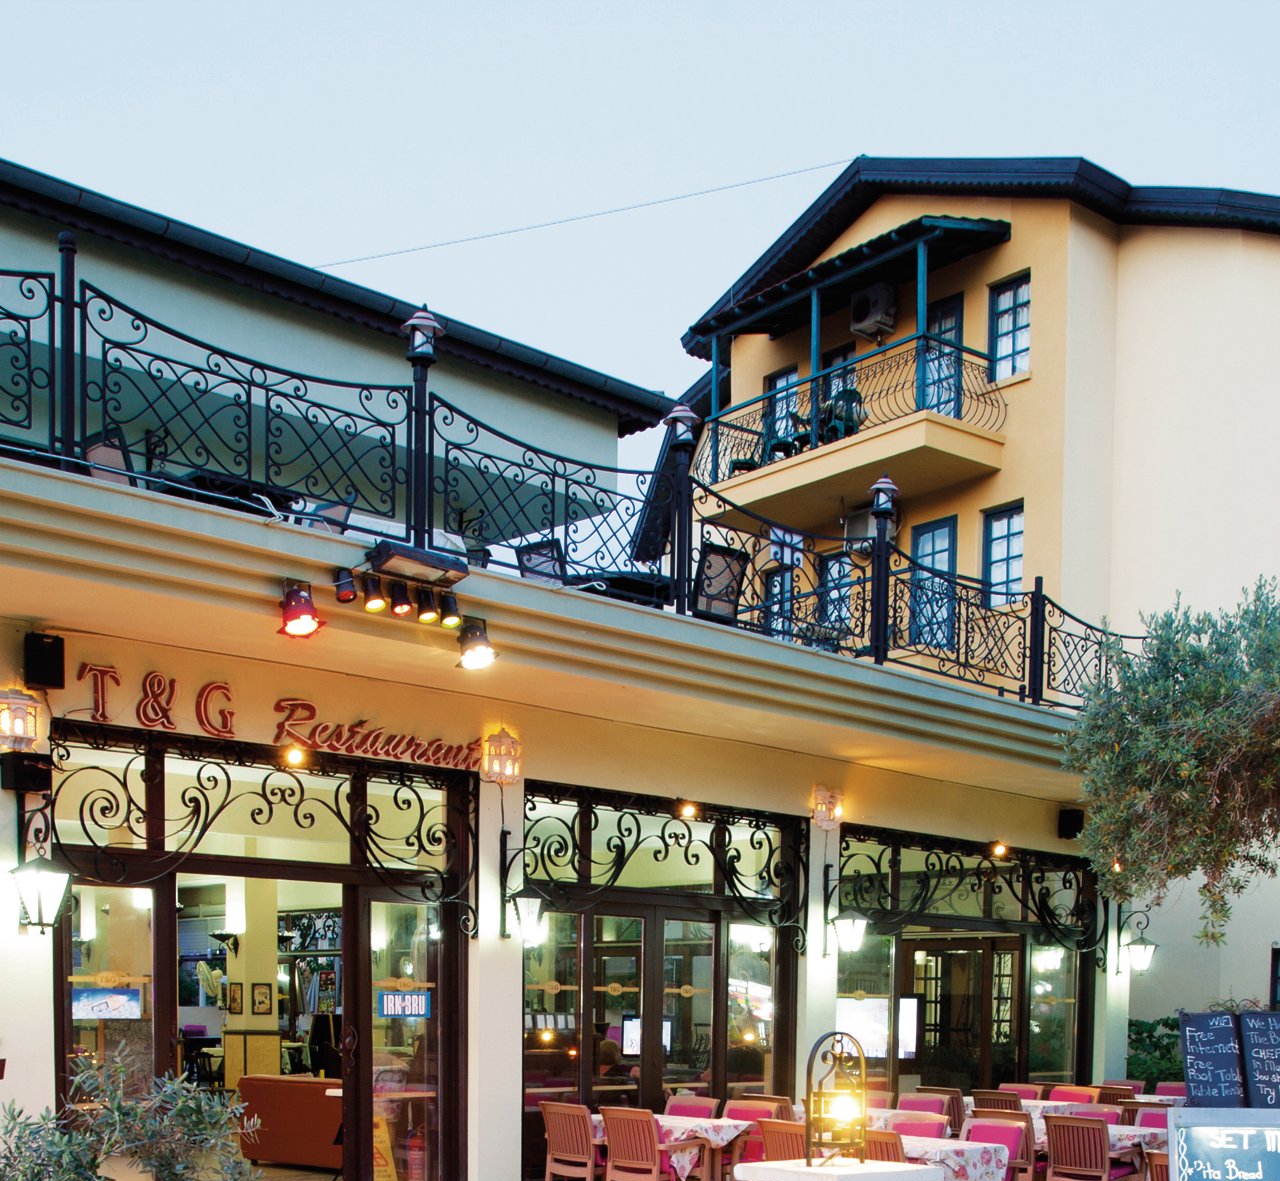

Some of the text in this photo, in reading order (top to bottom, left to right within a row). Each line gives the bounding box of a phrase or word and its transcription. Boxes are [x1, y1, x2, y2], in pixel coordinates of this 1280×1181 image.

[76, 661, 484, 771] T & G Restaurant
[383, 994, 426, 1015] IRN-BRU
[1246, 1018, 1266, 1029] We
[1186, 1026, 1215, 1041] Free
[1246, 1031, 1270, 1044] The
[1187, 1055, 1214, 1069] Free
[1188, 1068, 1212, 1081] Pool
[1188, 1083, 1219, 1097] Table
[1256, 1083, 1276, 1104] Try
[1209, 1129, 1256, 1150] SET
[1224, 1159, 1263, 1181] Bread
